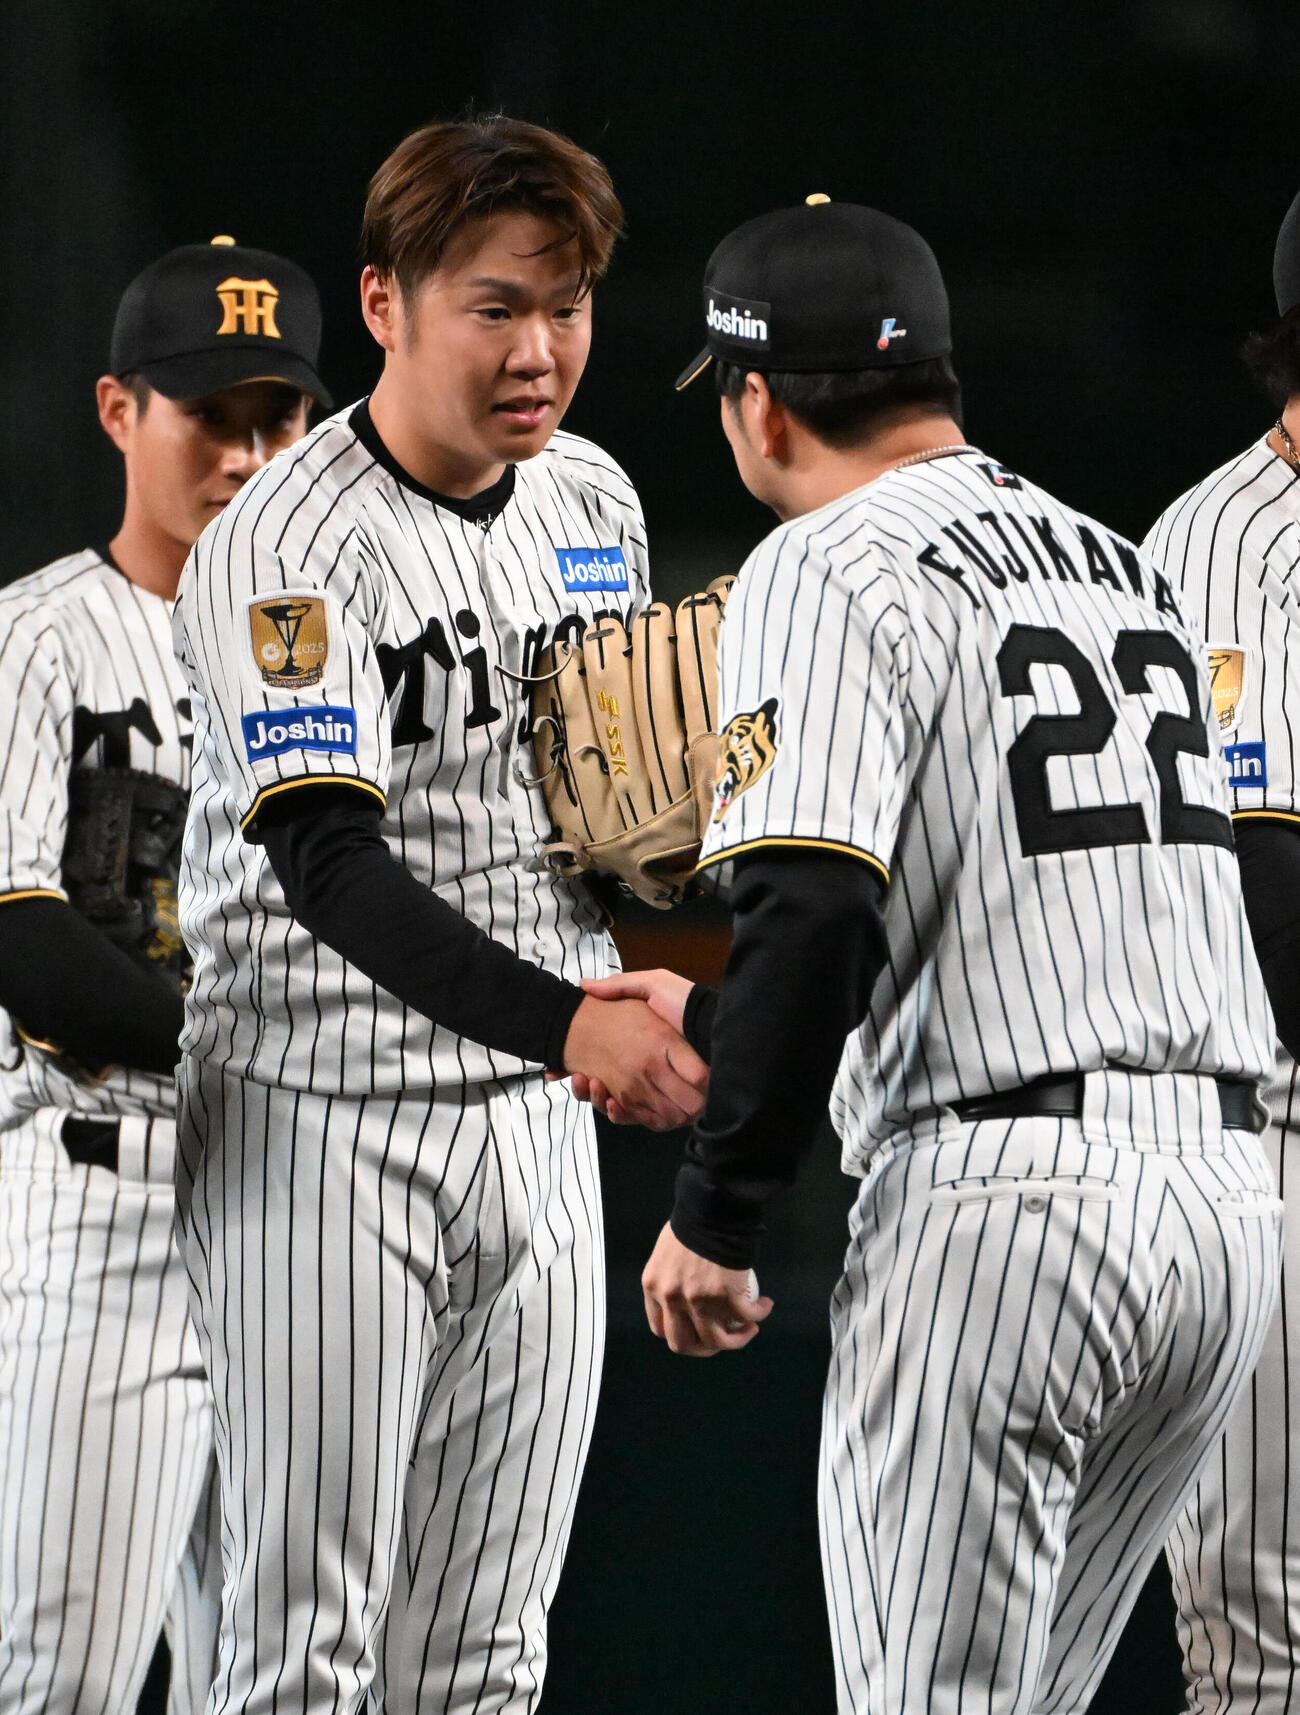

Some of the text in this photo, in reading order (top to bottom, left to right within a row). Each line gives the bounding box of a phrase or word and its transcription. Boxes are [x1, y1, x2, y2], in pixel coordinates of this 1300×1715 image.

[706, 299, 768, 341] Joshin
[562, 556, 627, 584] Joshin
[249, 715, 353, 750] Joshin
[605, 724, 628, 776] SSK
[995, 622, 1237, 858] 22
